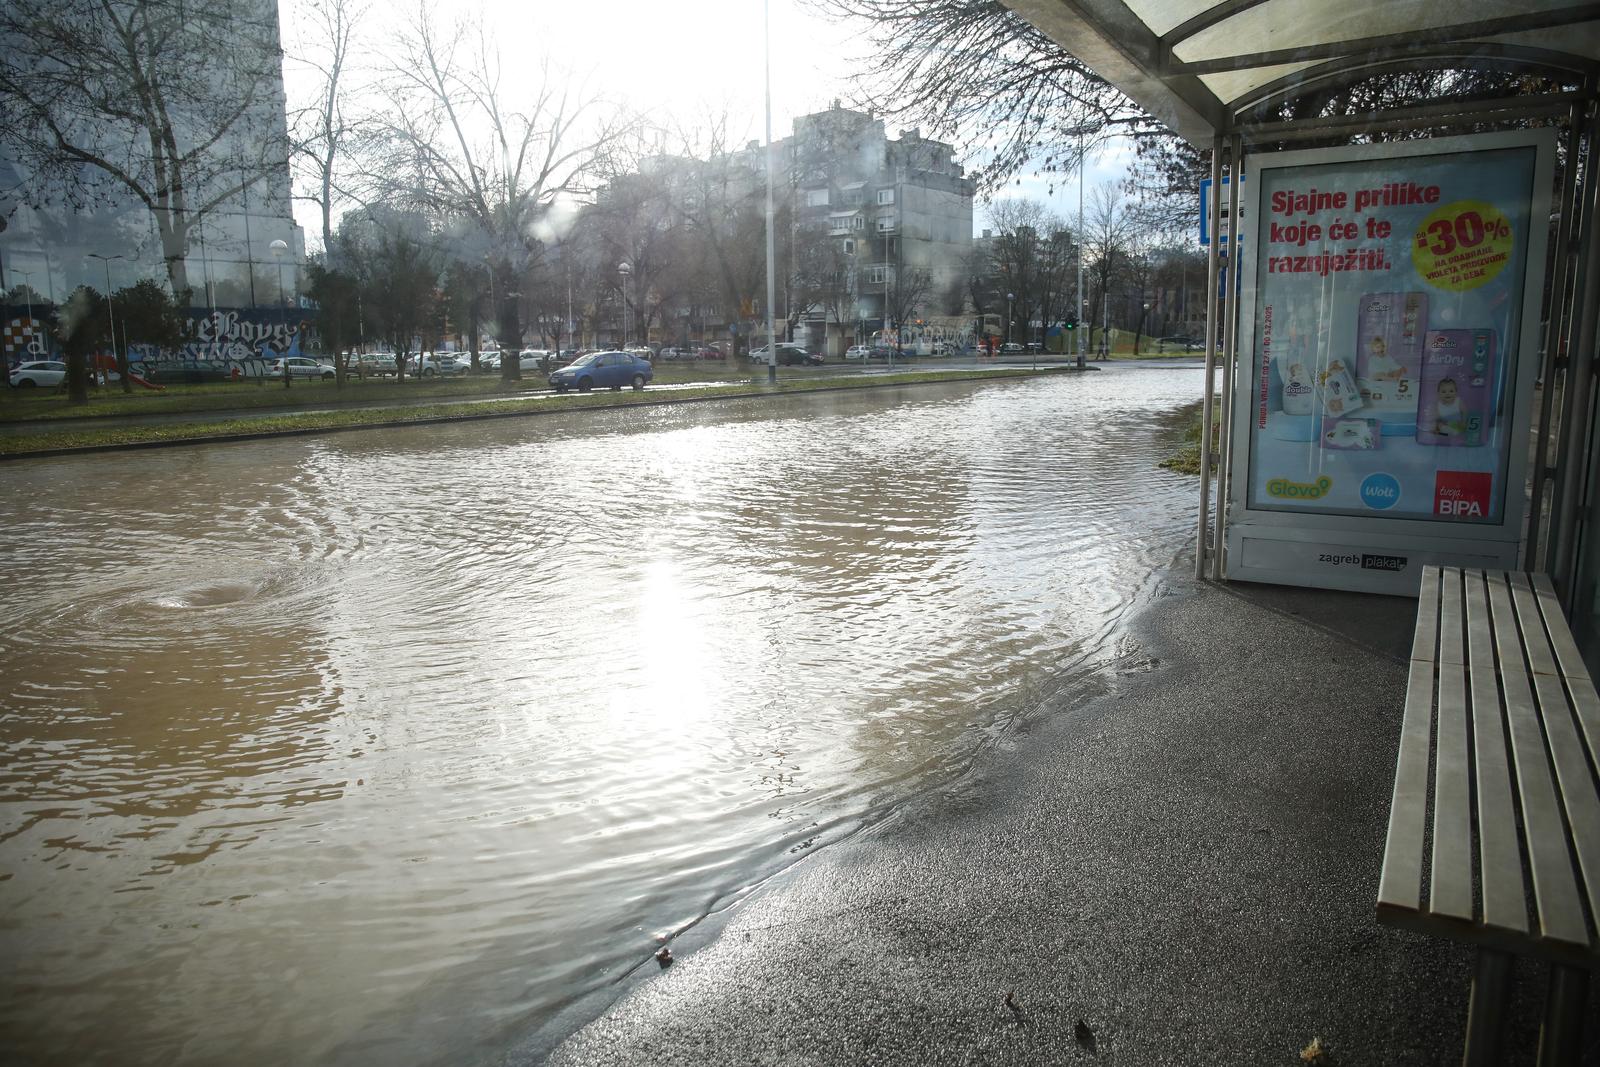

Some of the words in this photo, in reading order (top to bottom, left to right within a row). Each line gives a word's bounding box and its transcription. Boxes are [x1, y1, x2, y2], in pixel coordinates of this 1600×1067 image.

[1271, 188, 1348, 217] Sjajne
[1354, 182, 1441, 212] prilike
[1270, 220, 1322, 247] koje
[1328, 218, 1358, 241] će
[1366, 217, 1392, 239] te
[1268, 247, 1391, 277] raznježiti.
[1425, 265, 1458, 280] VIOLETA
[1460, 251, 1507, 270] PROIZVODE
[1434, 259, 1447, 269] NA
[1448, 246, 1495, 264] ODABRANE
[1428, 353, 1465, 366] AirDry
[1285, 386, 1312, 394] double
[1398, 379, 1409, 393] 5
[1468, 417, 1481, 431] 5
[1270, 480, 1322, 498] Glovo
[1365, 486, 1394, 498] Wolt
[1439, 500, 1482, 517] BIPA
[1319, 554, 1361, 566] zagreb
